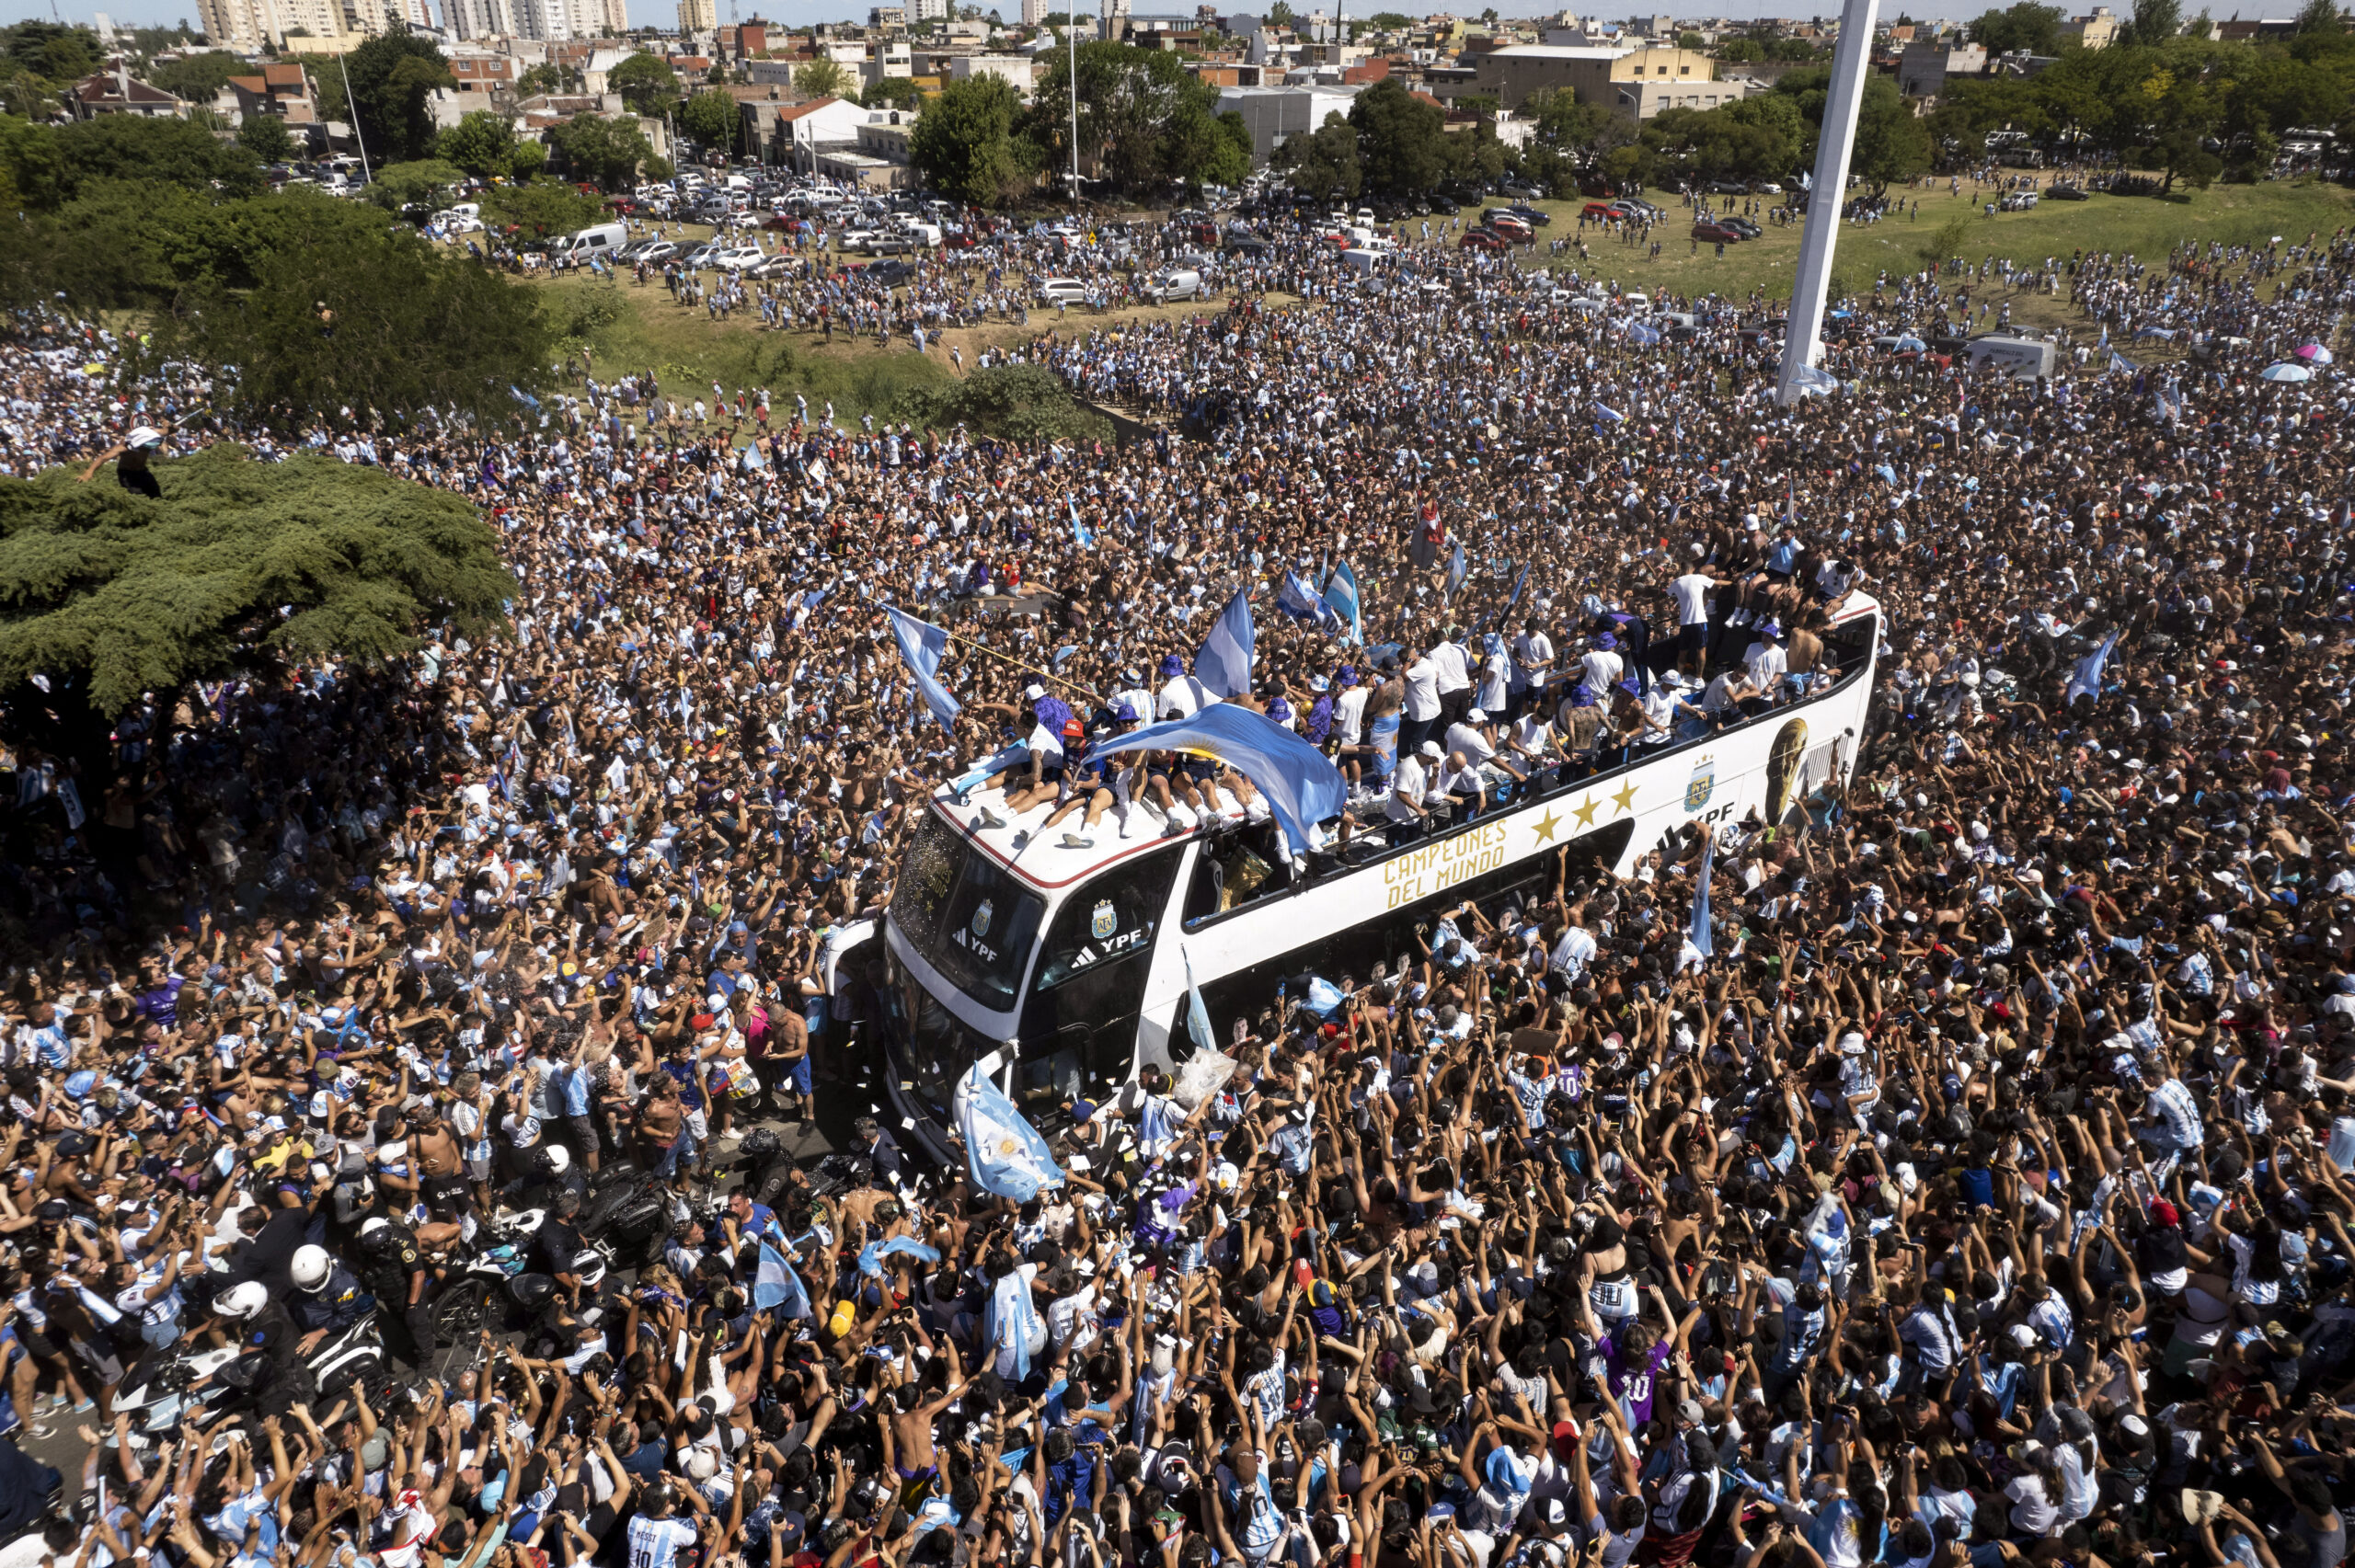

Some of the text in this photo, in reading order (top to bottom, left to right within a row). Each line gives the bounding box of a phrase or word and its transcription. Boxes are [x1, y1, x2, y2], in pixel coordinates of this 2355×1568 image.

[1697, 801, 1735, 826] PF
[1384, 818, 1507, 885] CAMPEONES
[1387, 845, 1504, 910] DEL MUNDO
[971, 936, 997, 962] YPF
[1100, 929, 1142, 953] YPF
[1557, 1077, 1578, 1096] 10
[636, 1529, 657, 1543] MESSI
[635, 1548, 651, 1568] 10
